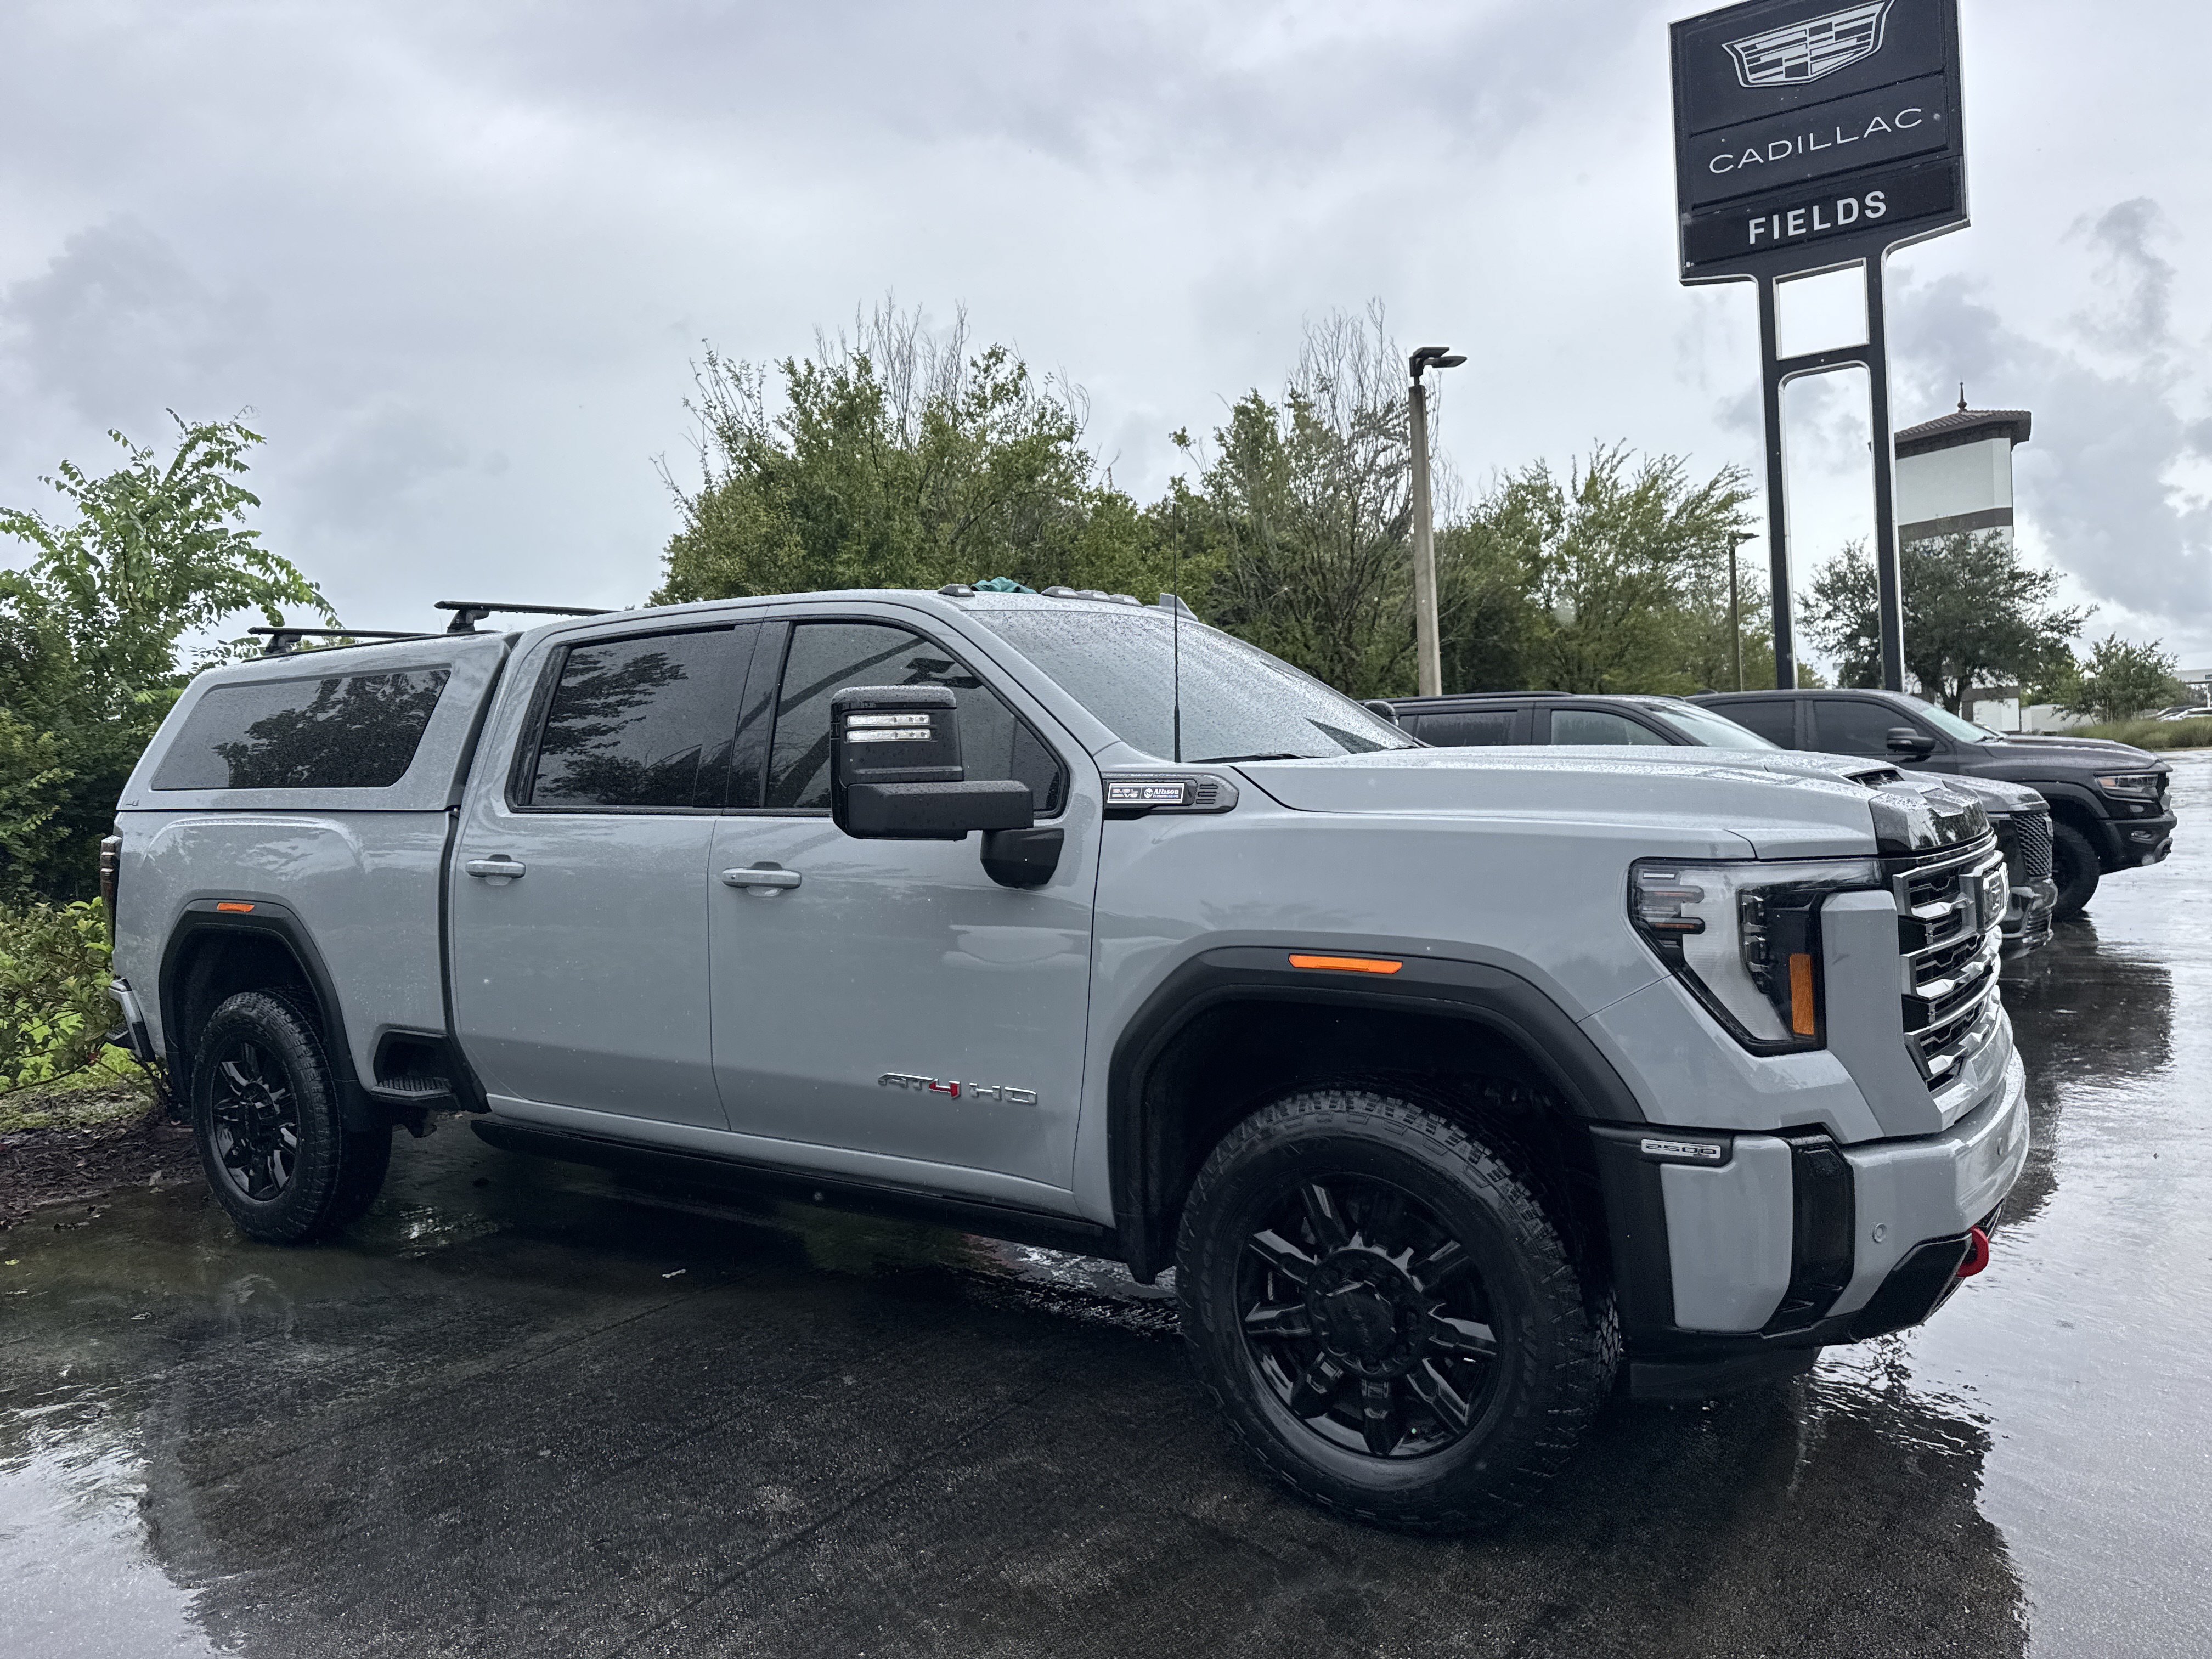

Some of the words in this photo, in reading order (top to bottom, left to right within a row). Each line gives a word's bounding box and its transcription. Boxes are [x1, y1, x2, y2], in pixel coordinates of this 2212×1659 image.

[1709, 108, 1922, 174] CADILLAC
[1748, 190, 1887, 245] FIELDS
[878, 1072, 961, 1098] AT4
[969, 1082, 1037, 1104] HD
[1645, 1143, 1717, 1155] 2500
